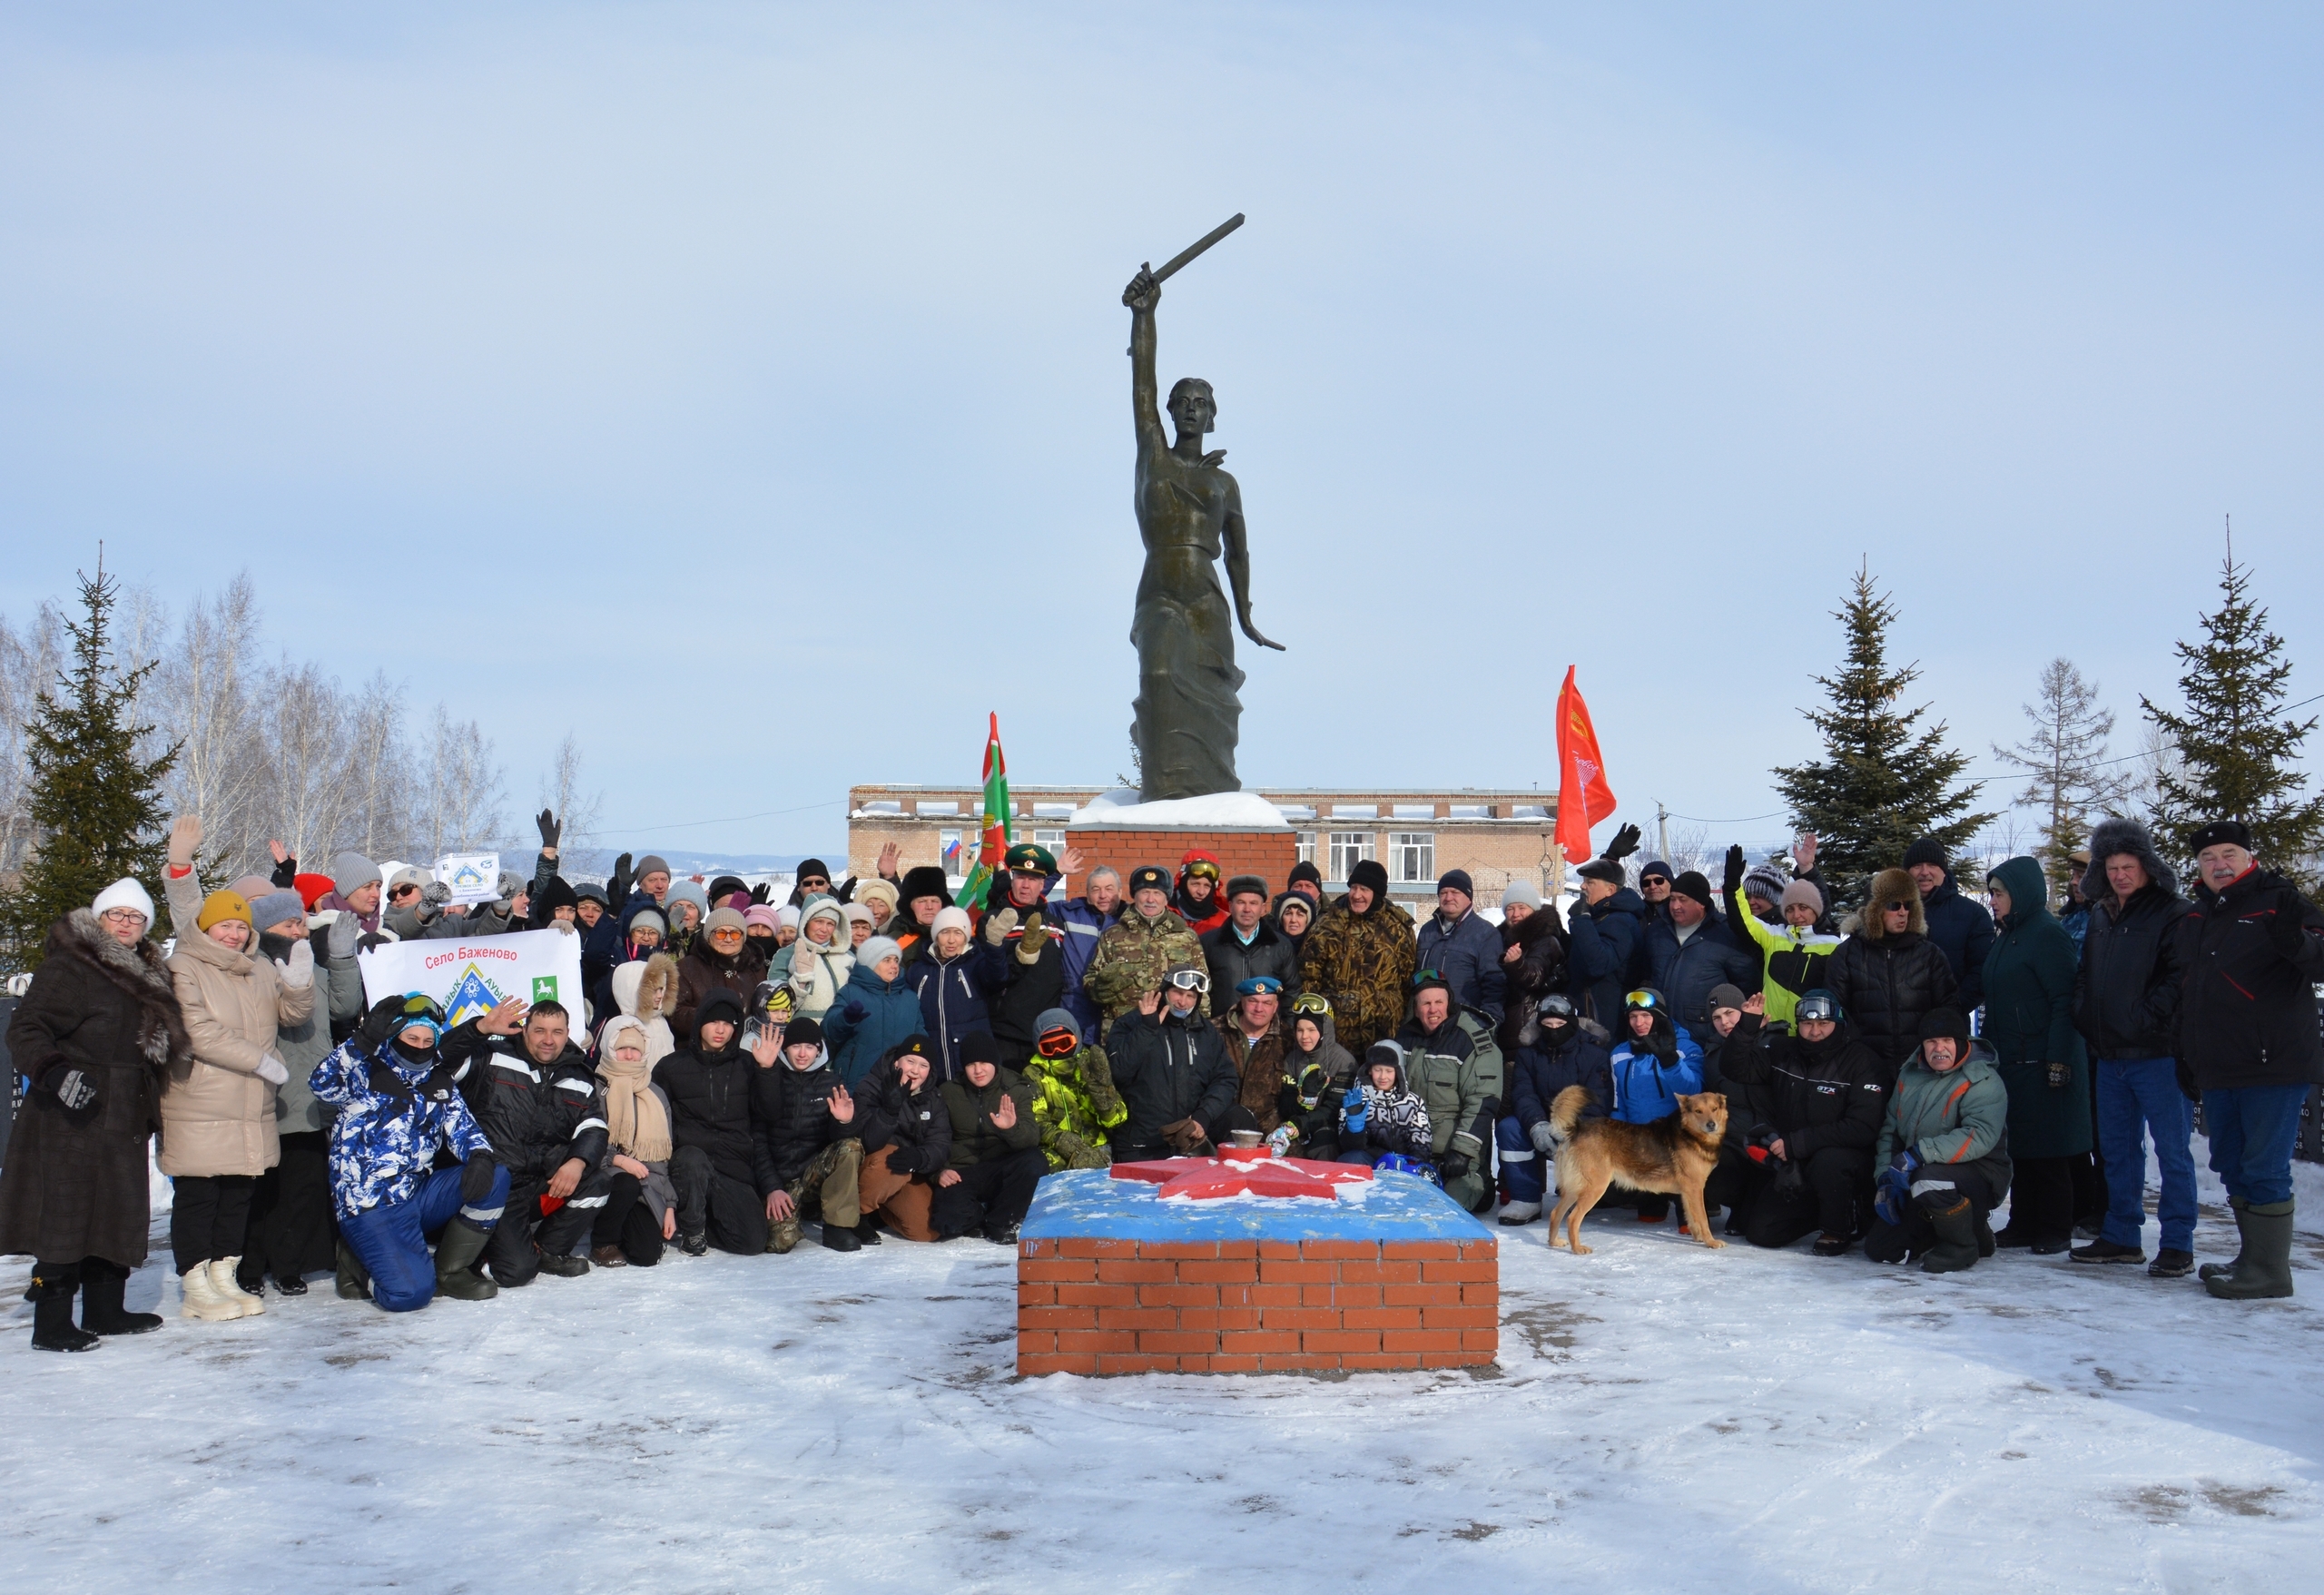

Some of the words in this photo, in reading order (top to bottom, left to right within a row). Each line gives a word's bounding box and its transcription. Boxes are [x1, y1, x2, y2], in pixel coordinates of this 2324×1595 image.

[425, 951, 455, 970] Село
[458, 947, 517, 961] Баженово
[1817, 1085, 1837, 1093] GTX
[1864, 1084, 1882, 1092] GTX
